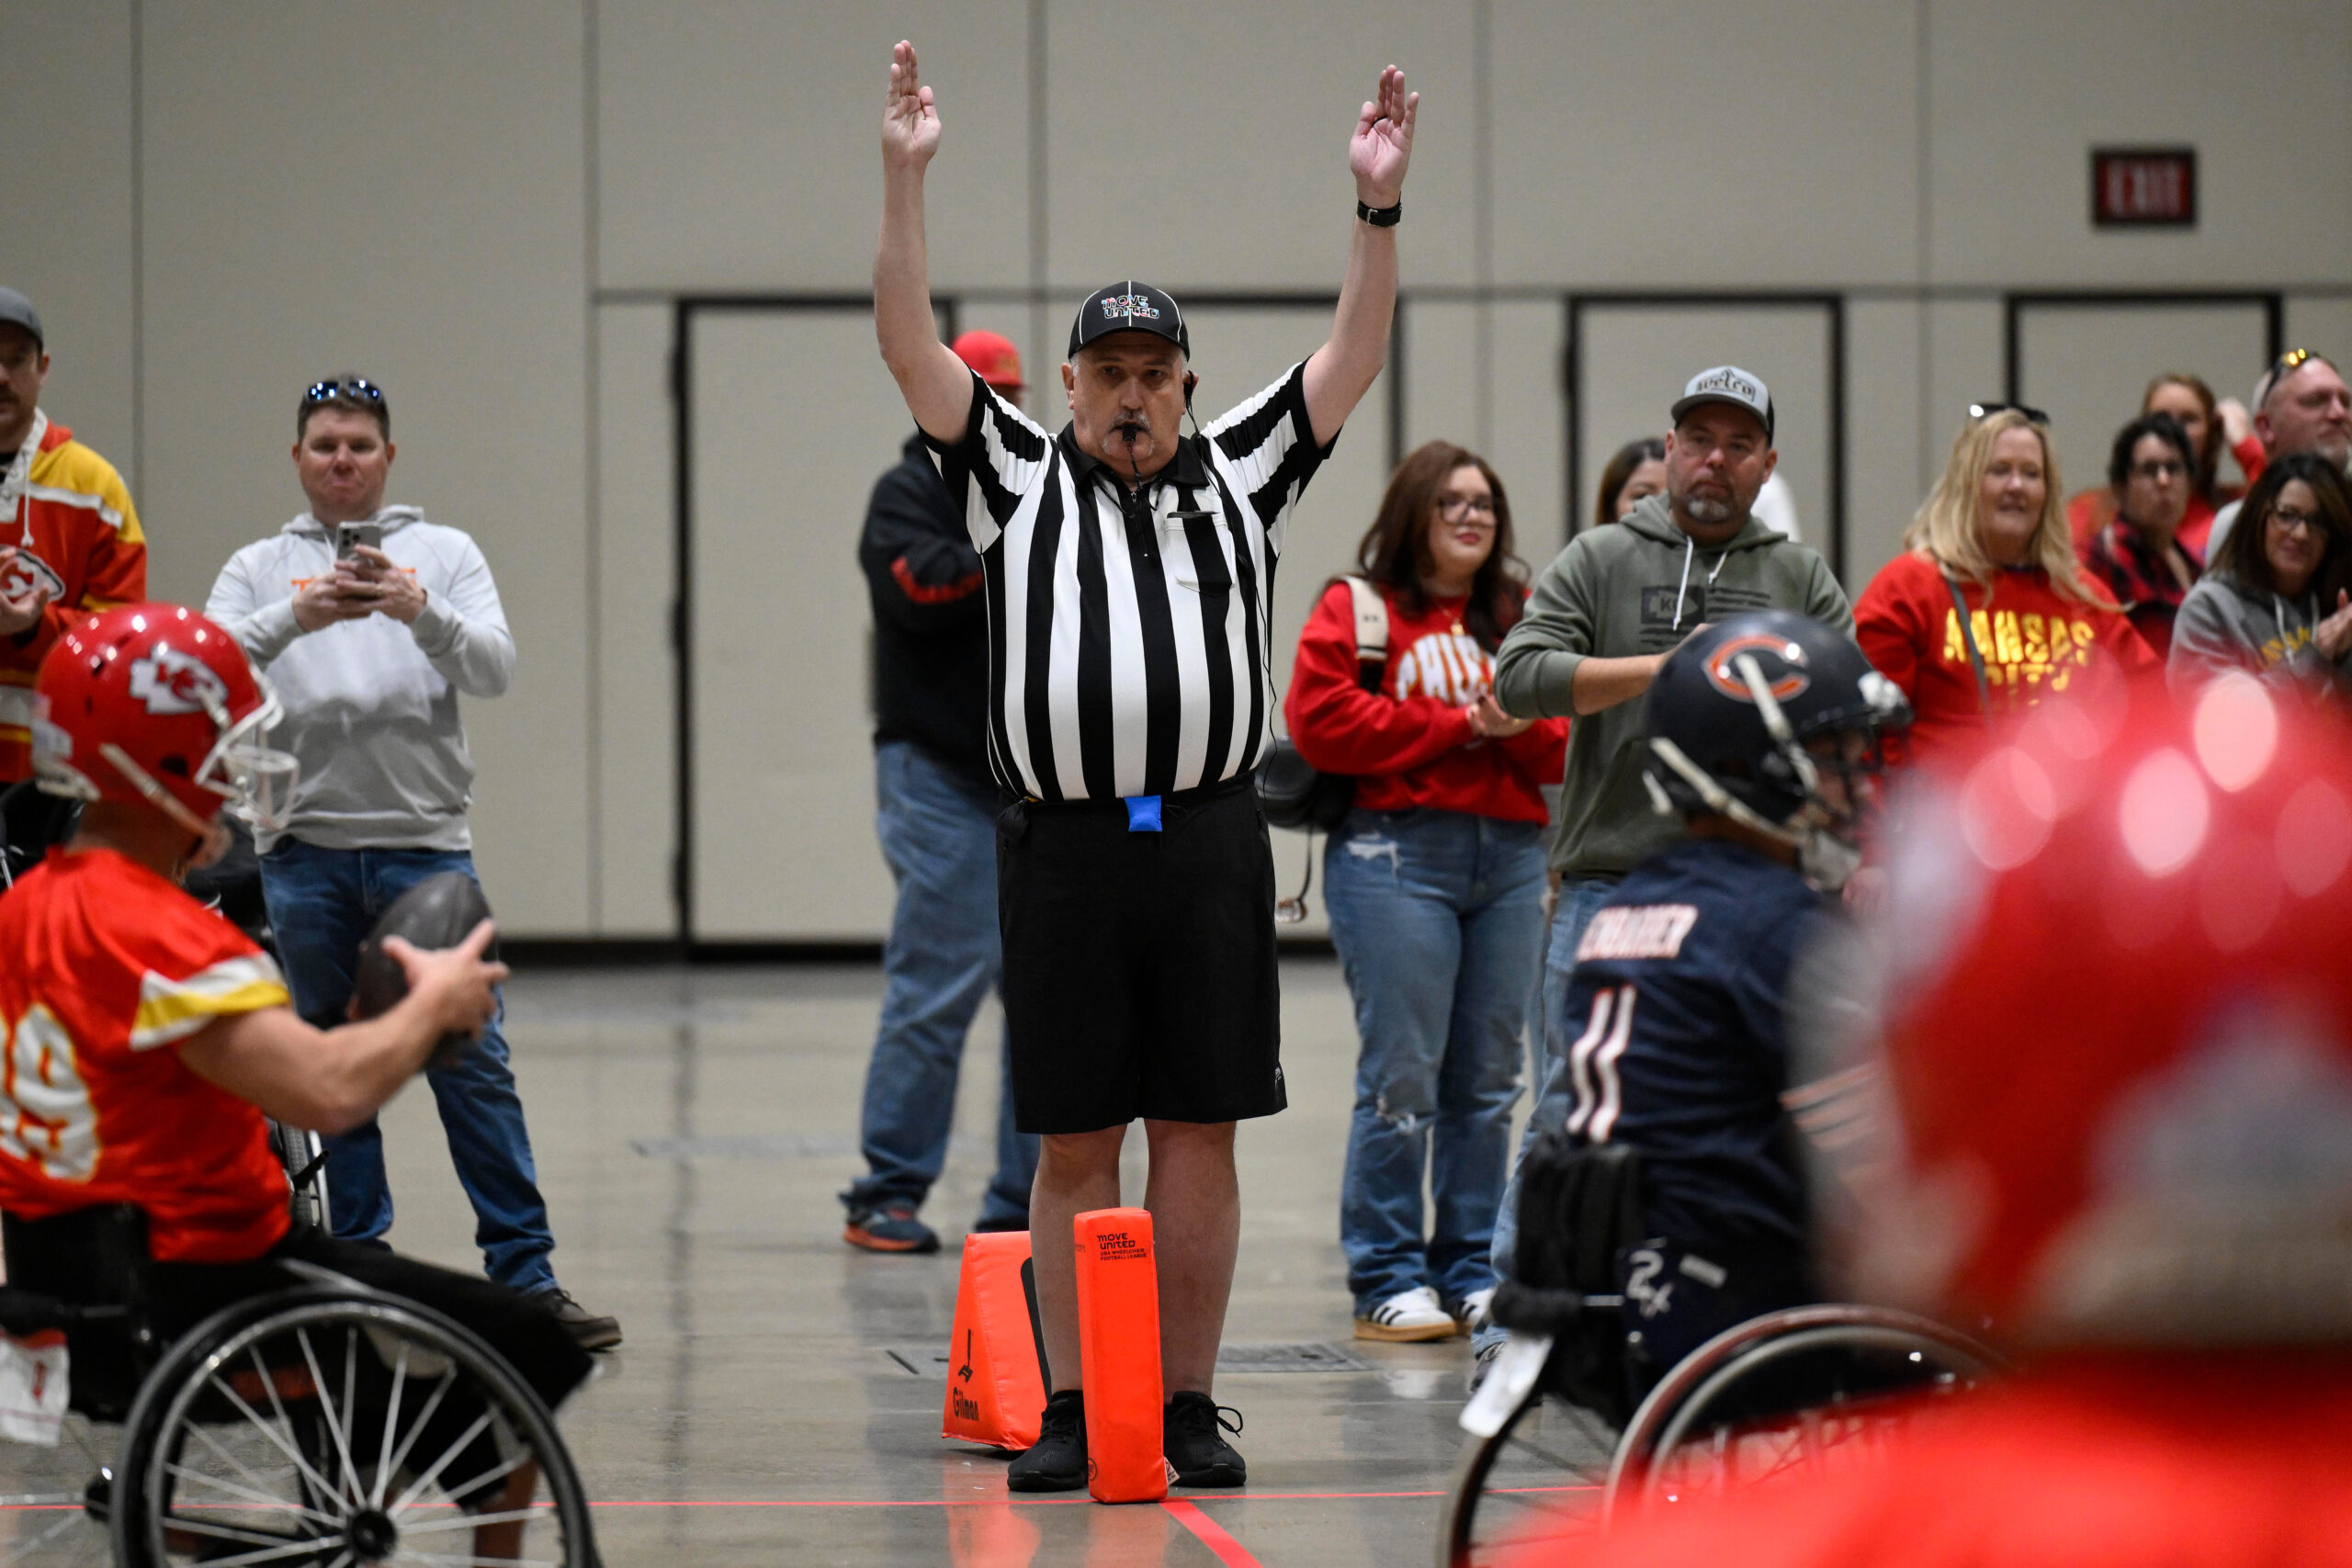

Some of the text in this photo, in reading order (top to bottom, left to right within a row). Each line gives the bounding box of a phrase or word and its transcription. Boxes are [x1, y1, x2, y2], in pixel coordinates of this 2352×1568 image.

[1102, 294, 1148, 310] MOVE
[1104, 306, 1159, 319] UNITED
[1566, 983, 1637, 1145] 11
[1097, 1233, 1128, 1242] MOVE
[1100, 1240, 1136, 1250] UNITED
